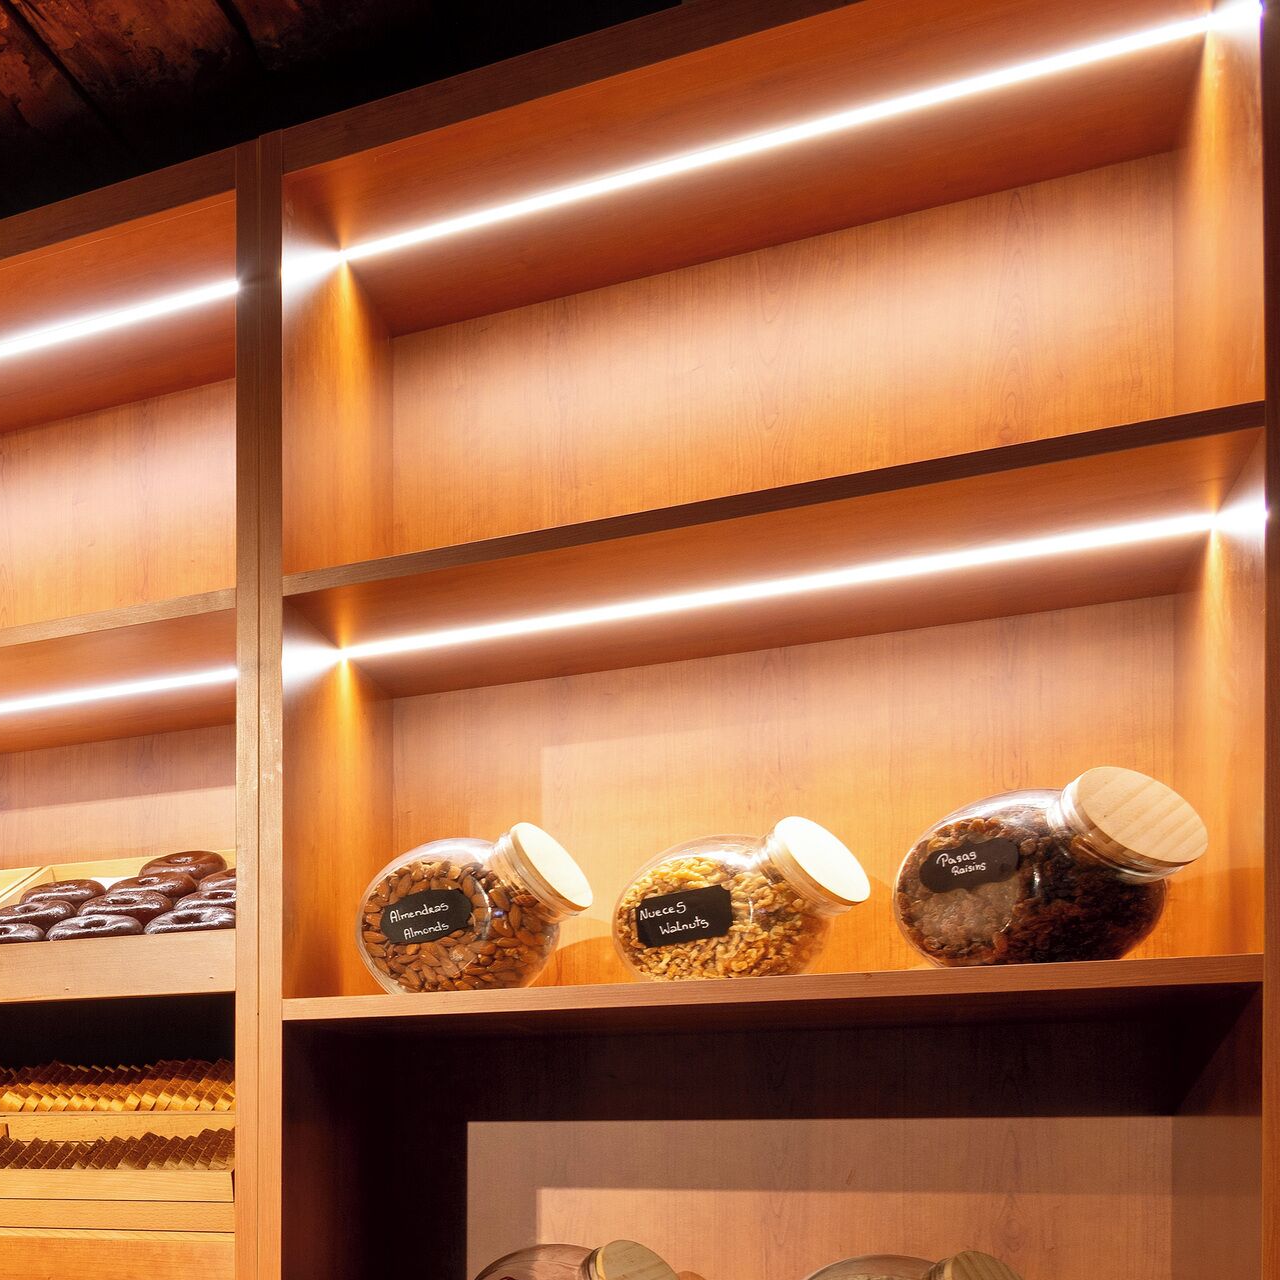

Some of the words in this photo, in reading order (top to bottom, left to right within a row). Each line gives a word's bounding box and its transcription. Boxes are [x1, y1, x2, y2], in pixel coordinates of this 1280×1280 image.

[936, 851, 977, 867] Pasas
[951, 862, 987, 876] Raisins
[403, 921, 449, 940] Almonds
[659, 915, 709, 935] Walnuts
